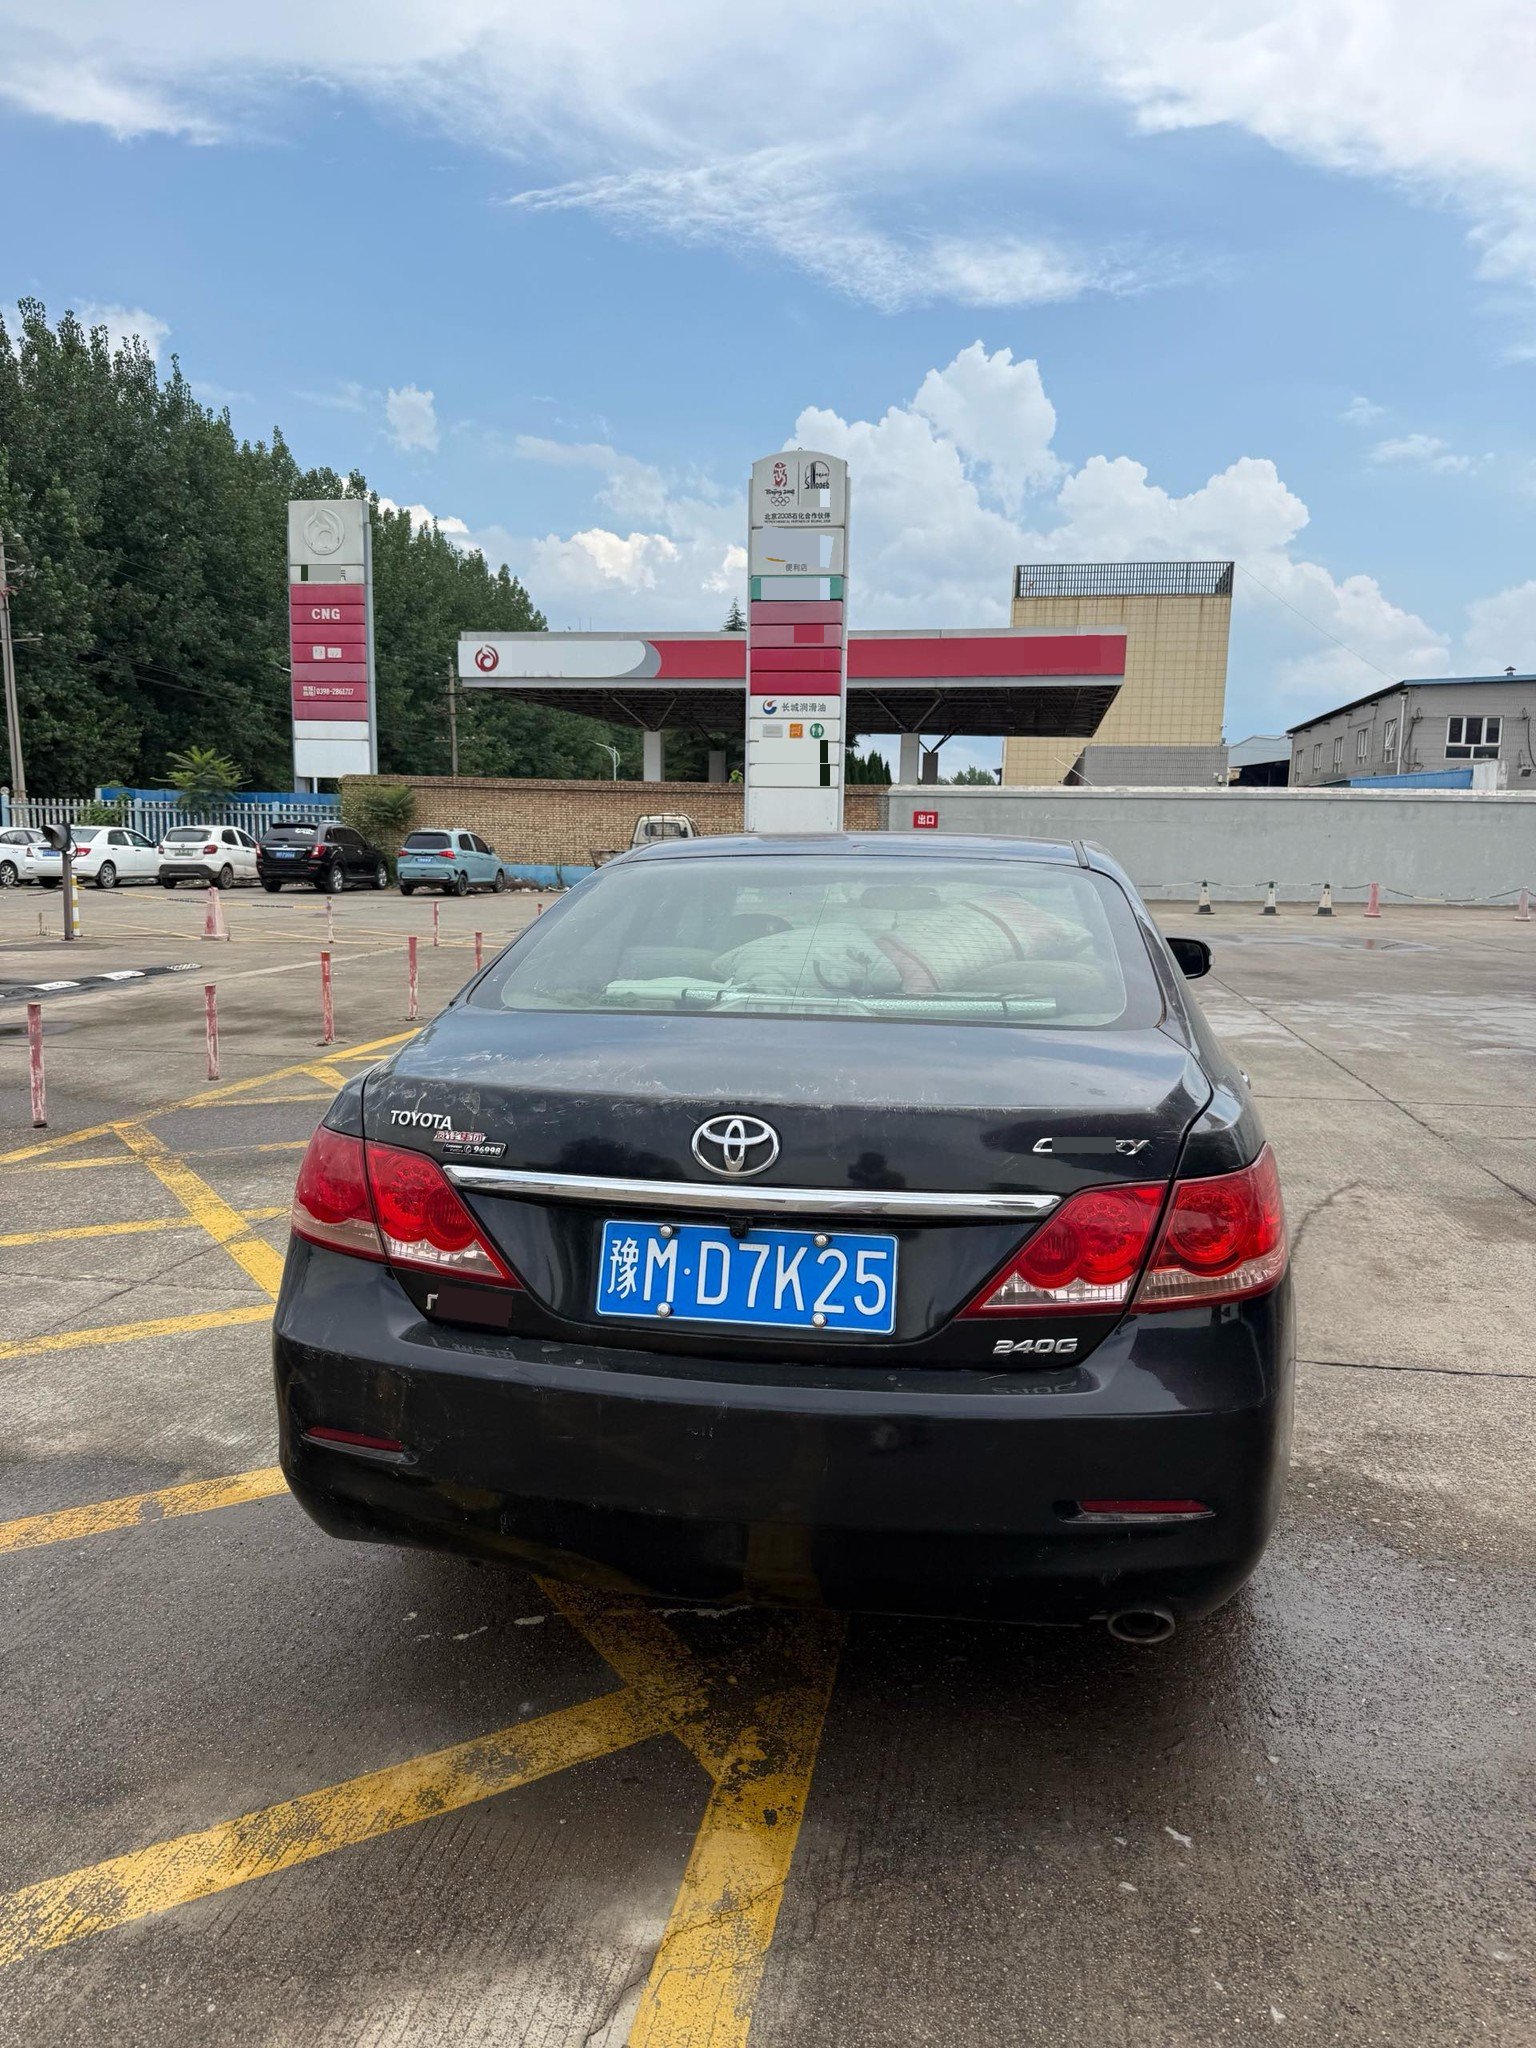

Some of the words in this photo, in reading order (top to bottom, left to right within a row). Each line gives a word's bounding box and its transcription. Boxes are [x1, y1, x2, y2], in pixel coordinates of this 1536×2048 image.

[785, 563, 808, 572] 便利店
[311, 608, 341, 620] CNG
[781, 702, 827, 713] 长城润滑油
[917, 814, 935, 825] 出口
[390, 1110, 452, 1131] TOYOTA
[473, 1145, 502, 1155] 96998
[992, 1338, 1079, 1354] 240G
